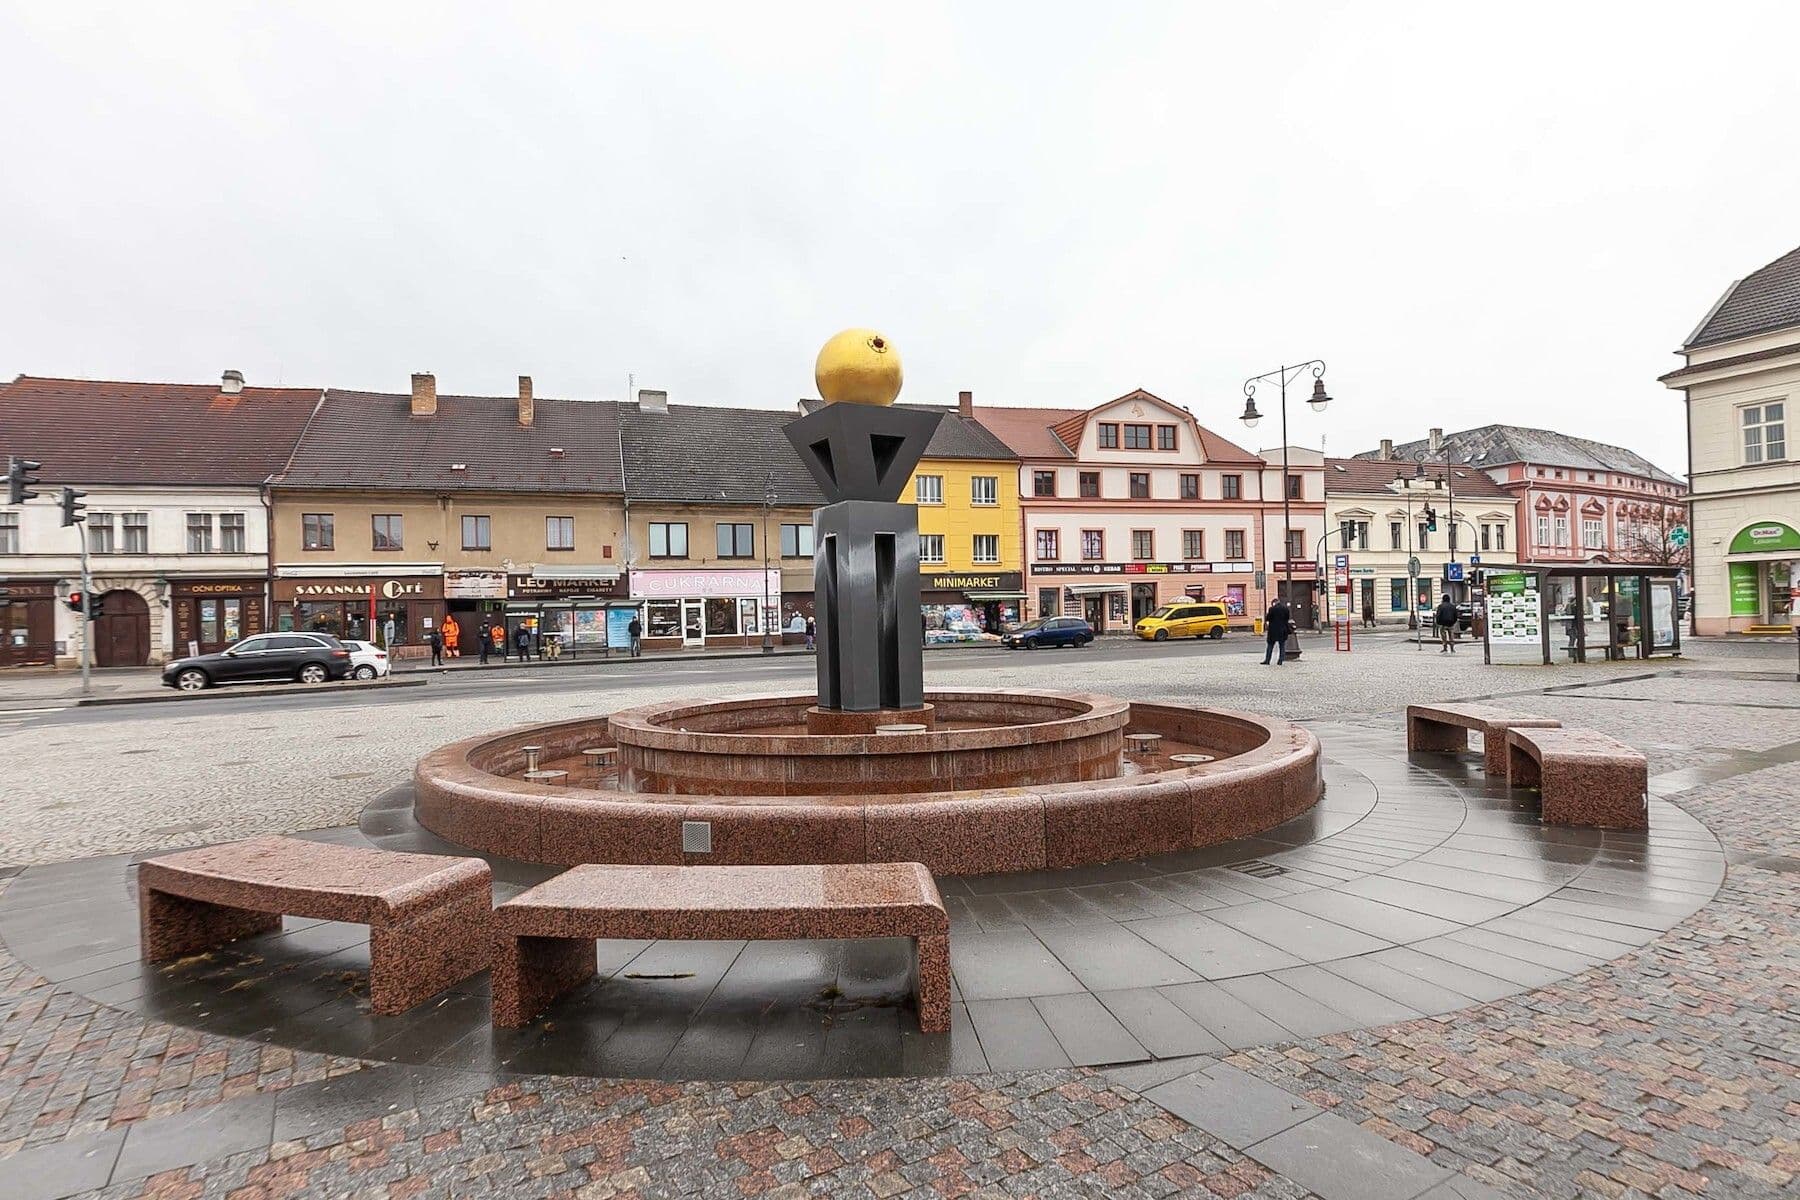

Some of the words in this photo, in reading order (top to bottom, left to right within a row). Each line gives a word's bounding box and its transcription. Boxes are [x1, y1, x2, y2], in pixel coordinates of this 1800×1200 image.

[214, 584, 242, 592] OPTIKA
[517, 577, 547, 588] LEO
[553, 579, 617, 587] MARKET
[934, 577, 1001, 588] MINIMARKET
